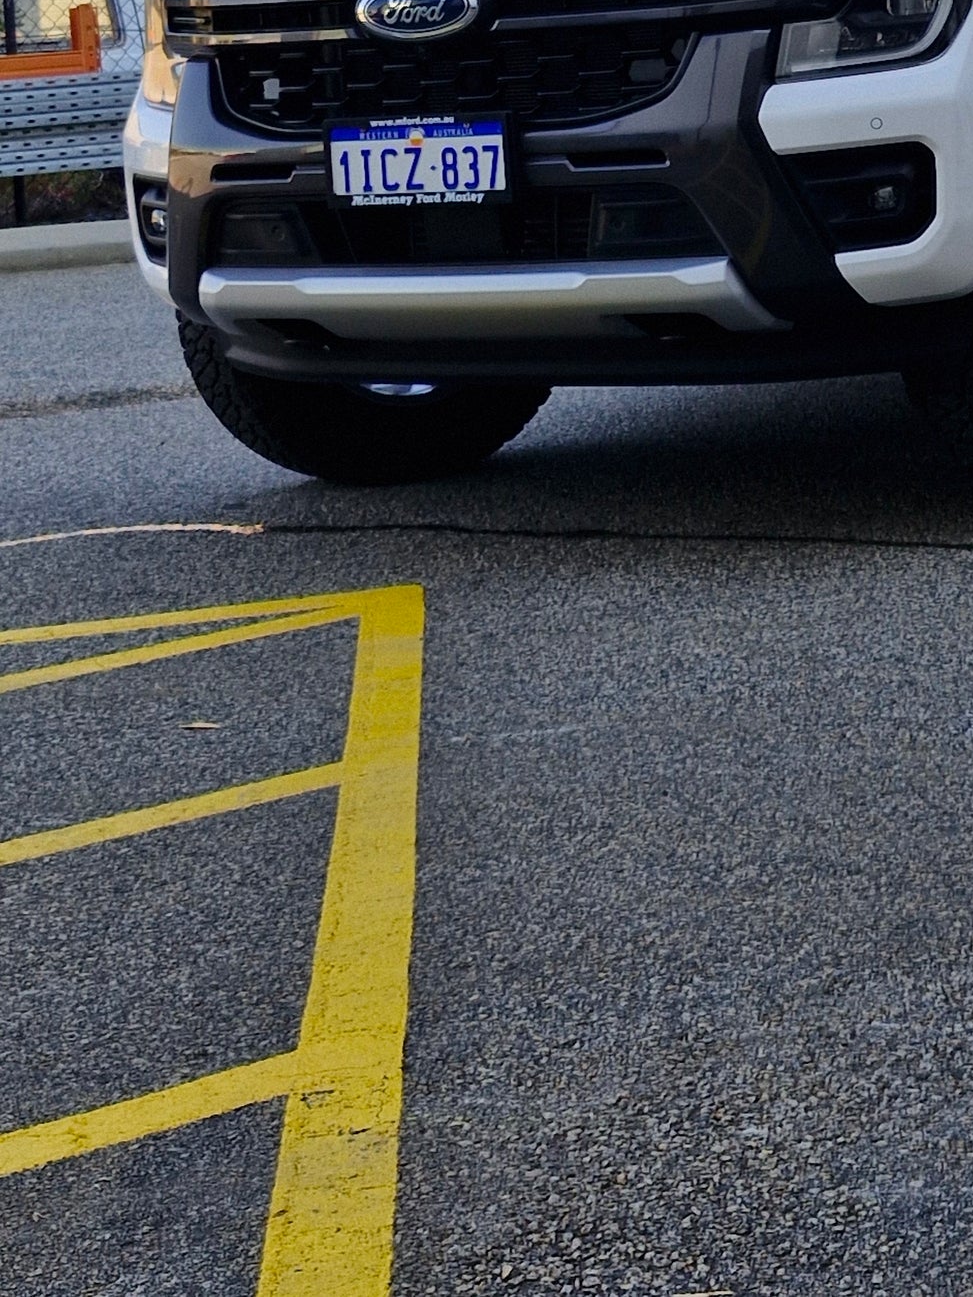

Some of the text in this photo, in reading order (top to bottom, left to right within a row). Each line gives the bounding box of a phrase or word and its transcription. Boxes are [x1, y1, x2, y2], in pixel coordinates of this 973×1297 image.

[359, 127, 474, 140] WESTERN AUSTRALIA
[416, 193, 441, 203] Ford
